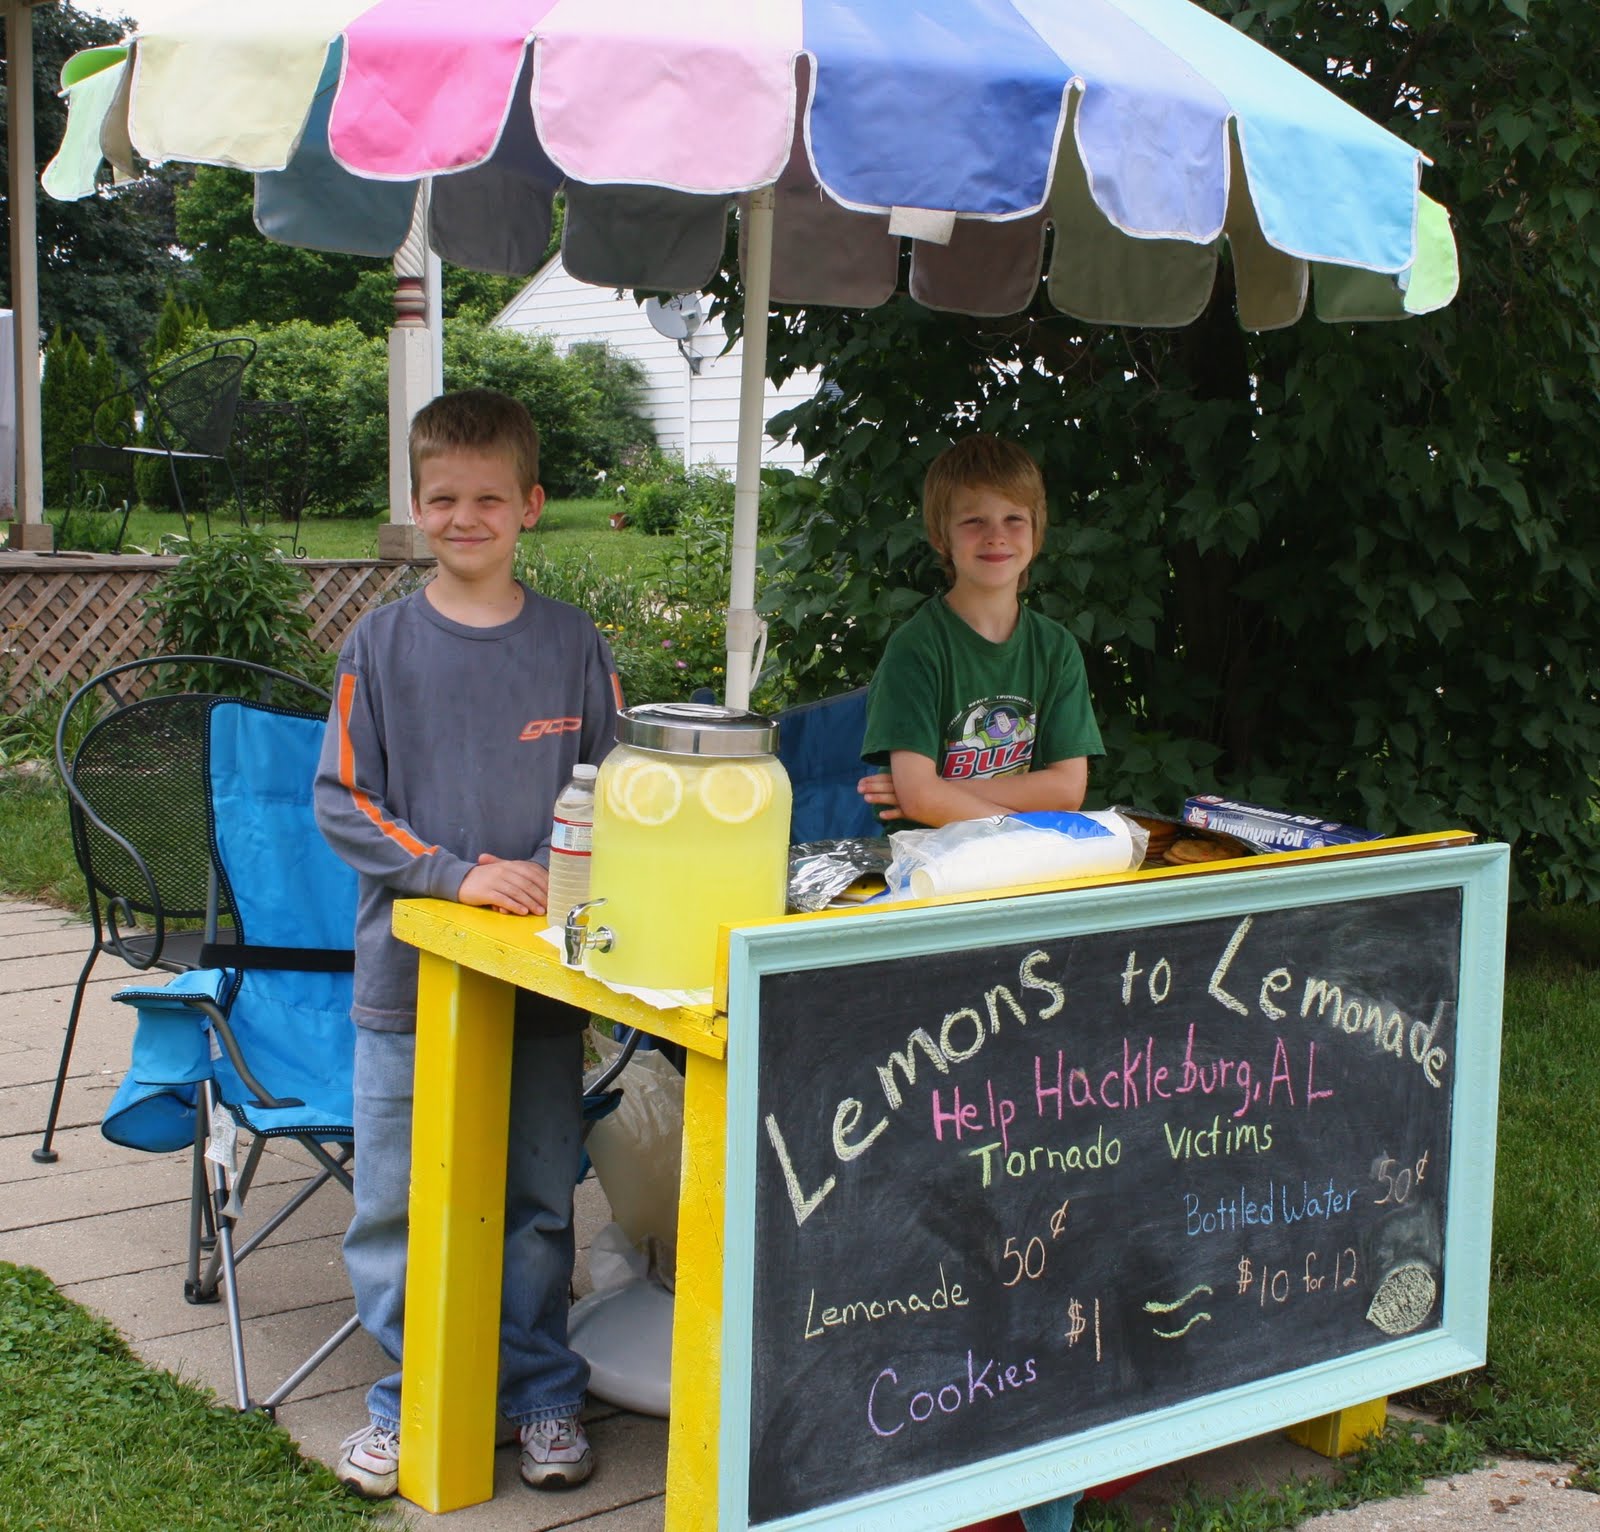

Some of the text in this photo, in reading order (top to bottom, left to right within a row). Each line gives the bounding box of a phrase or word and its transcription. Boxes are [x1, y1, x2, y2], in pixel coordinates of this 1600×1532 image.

[1208, 817, 1275, 844] Aluminum
[1276, 827, 1304, 848] Foil
[765, 914, 1447, 1227] Lemons to Lemonade
[931, 1079, 1016, 1158] Help
[968, 1115, 1273, 1189] Tornado Victims
[1183, 1179, 1274, 1236] Bottled
[1282, 1177, 1358, 1226] Water
[804, 1261, 970, 1341] Lemonade
[1236, 1246, 1358, 1308] $10 for 12
[867, 1297, 1102, 1437] Cookies $1
